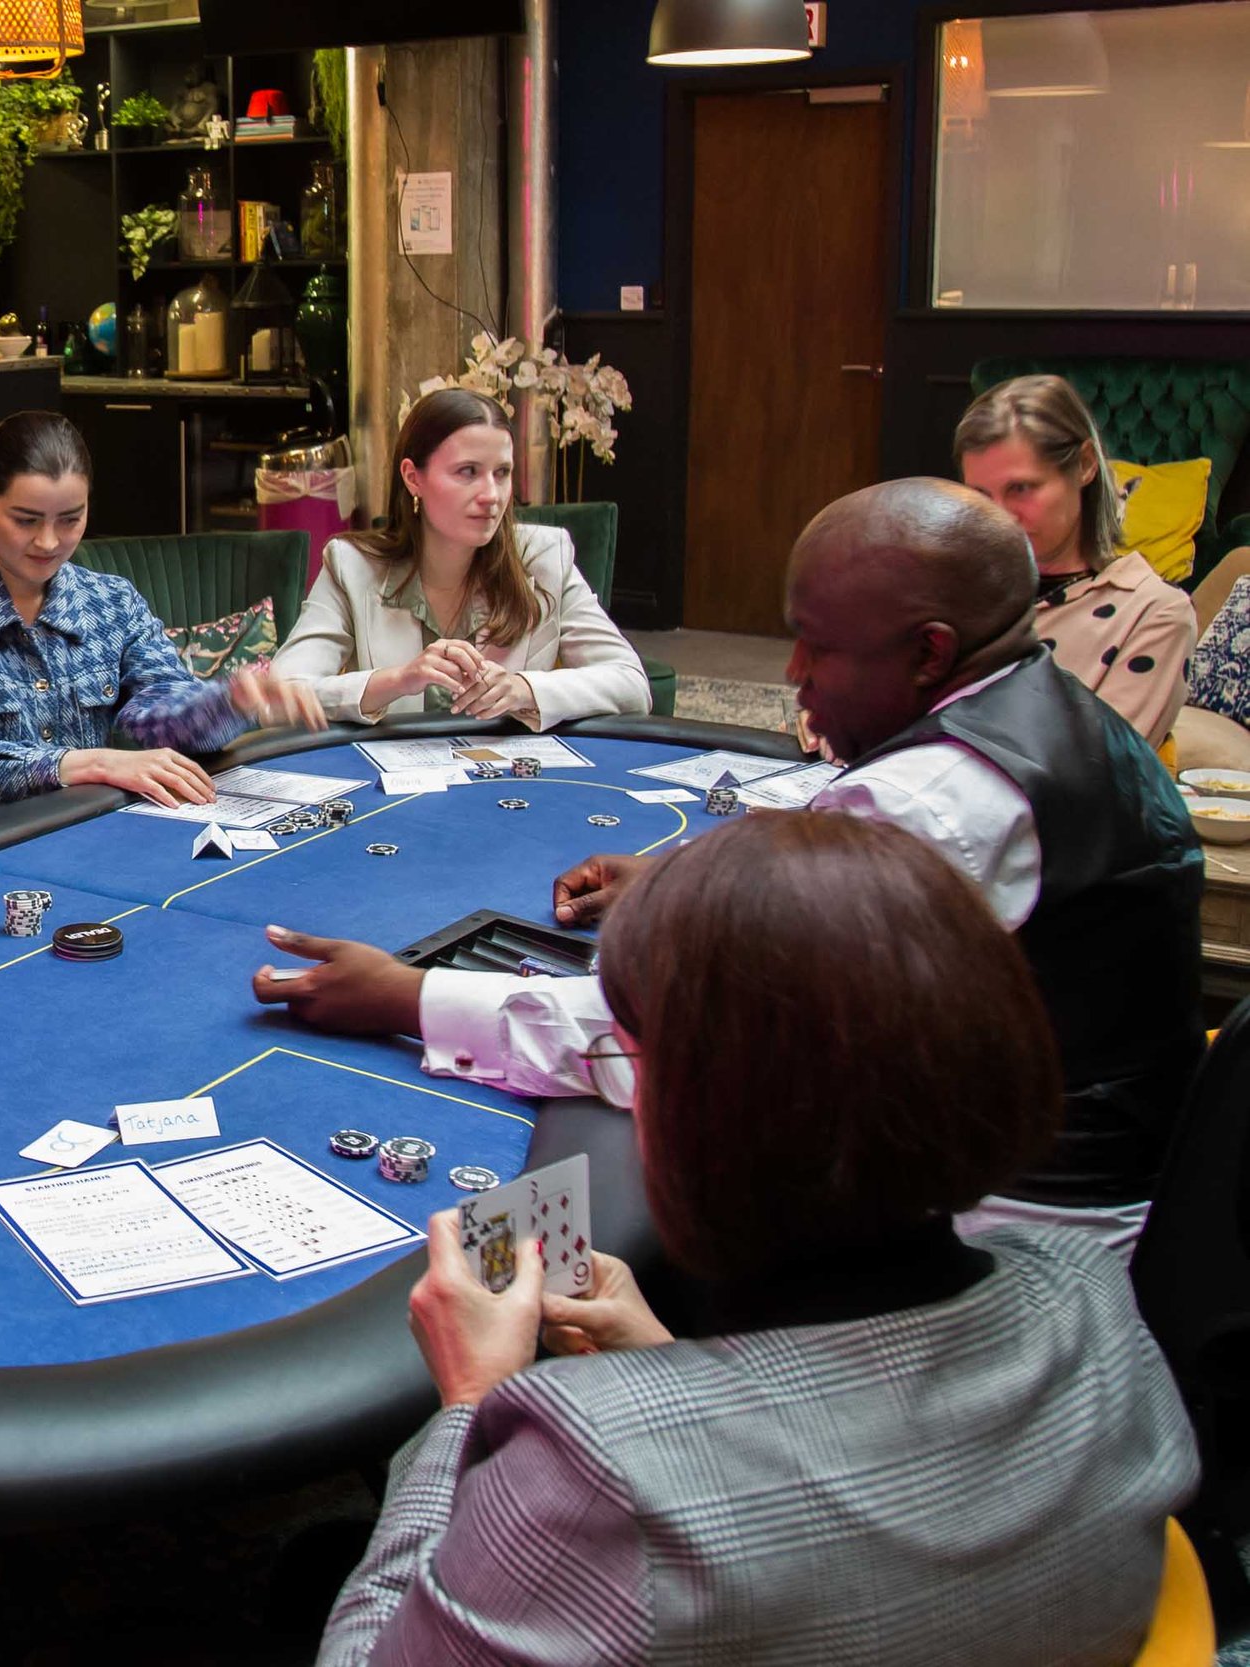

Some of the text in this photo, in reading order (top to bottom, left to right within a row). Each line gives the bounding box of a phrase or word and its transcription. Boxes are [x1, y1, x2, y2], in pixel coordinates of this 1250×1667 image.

[65, 927, 112, 940] DEALER
[124, 1113, 201, 1134] Tatjana
[461, 1201, 478, 1230] K
